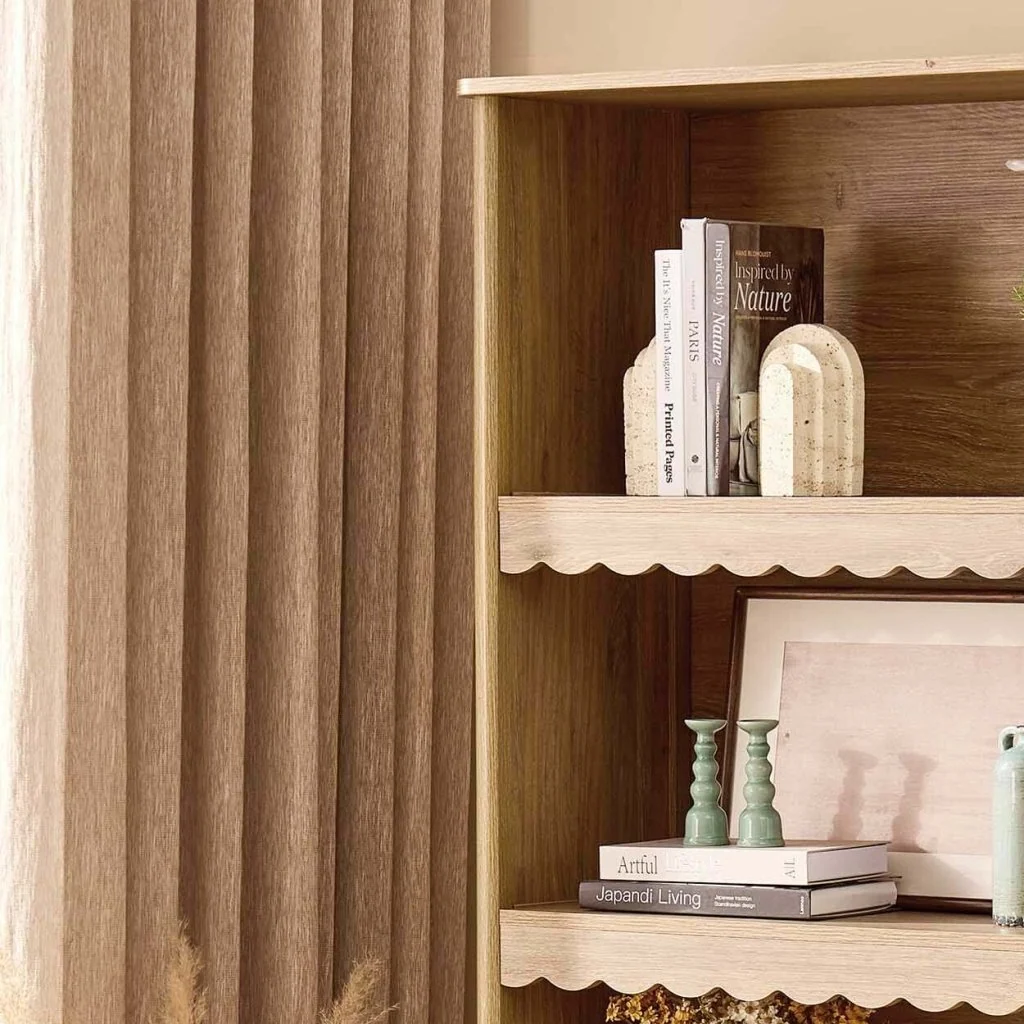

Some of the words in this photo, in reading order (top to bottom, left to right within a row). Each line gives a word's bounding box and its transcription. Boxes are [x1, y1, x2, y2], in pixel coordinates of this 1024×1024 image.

[662, 258, 672, 278] The
[713, 240, 725, 290] Inspired
[735, 261, 779, 284] Inspired
[781, 263, 794, 286] by
[663, 280, 672, 295] It's
[712, 291, 725, 306] by
[733, 281, 792, 313] Nature
[663, 297, 672, 319] Nice
[663, 321, 672, 343] That
[689, 320, 700, 362] PARIS
[712, 312, 726, 366] Nature
[663, 345, 673, 392] Magazine
[664, 403, 675, 447] Printed
[664, 450, 675, 484] Pages
[617, 854, 658, 875] Artful
[596, 886, 654, 905] Japandi
[658, 888, 702, 910] Living
